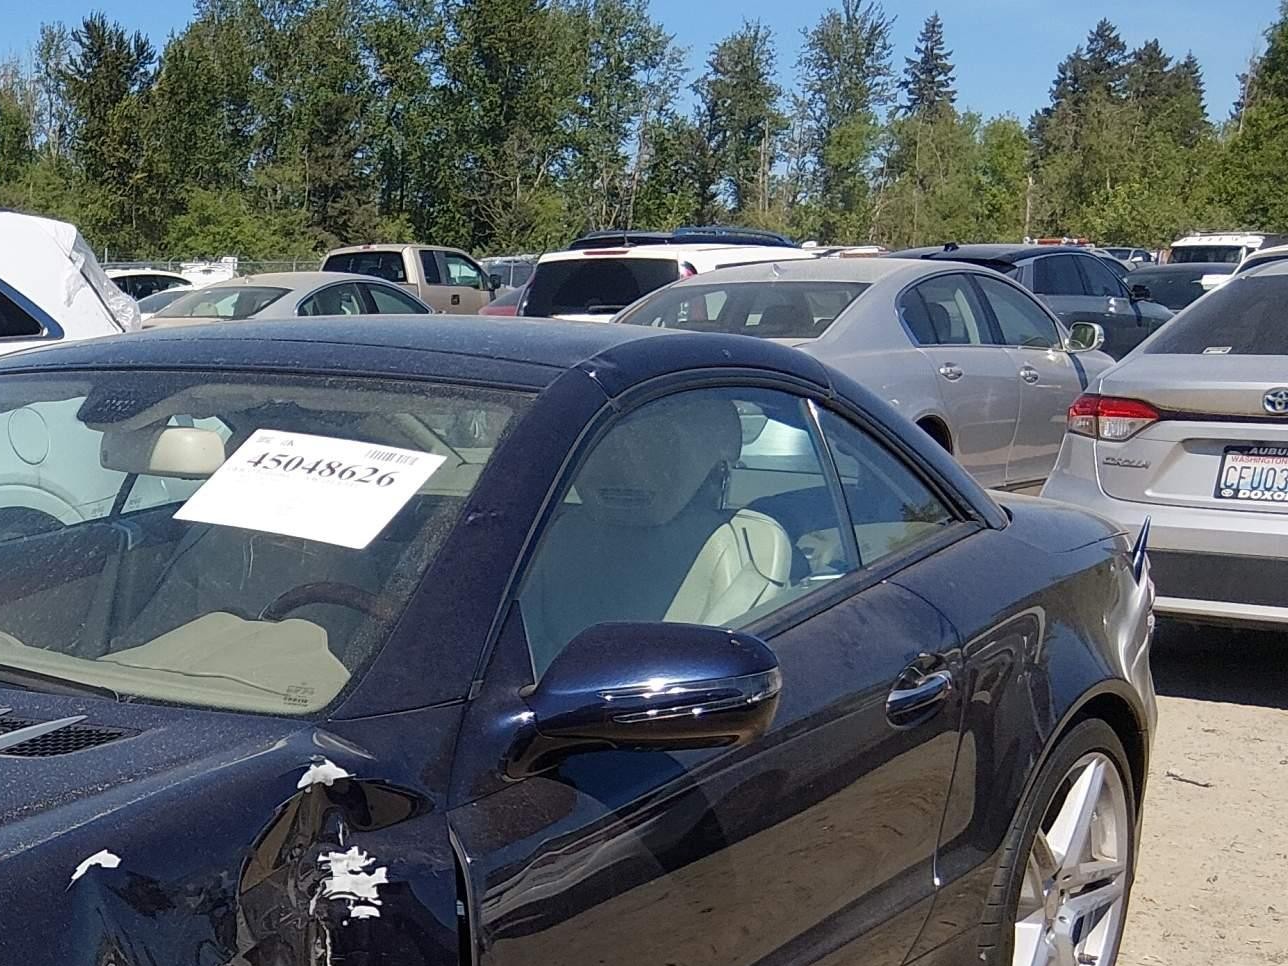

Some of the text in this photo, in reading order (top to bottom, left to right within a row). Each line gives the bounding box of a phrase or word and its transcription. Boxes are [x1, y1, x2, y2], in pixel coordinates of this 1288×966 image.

[1248, 447, 1288, 456] AUBU
[1231, 456, 1288, 465] WASHINGTON
[246, 452, 401, 488] 45048626
